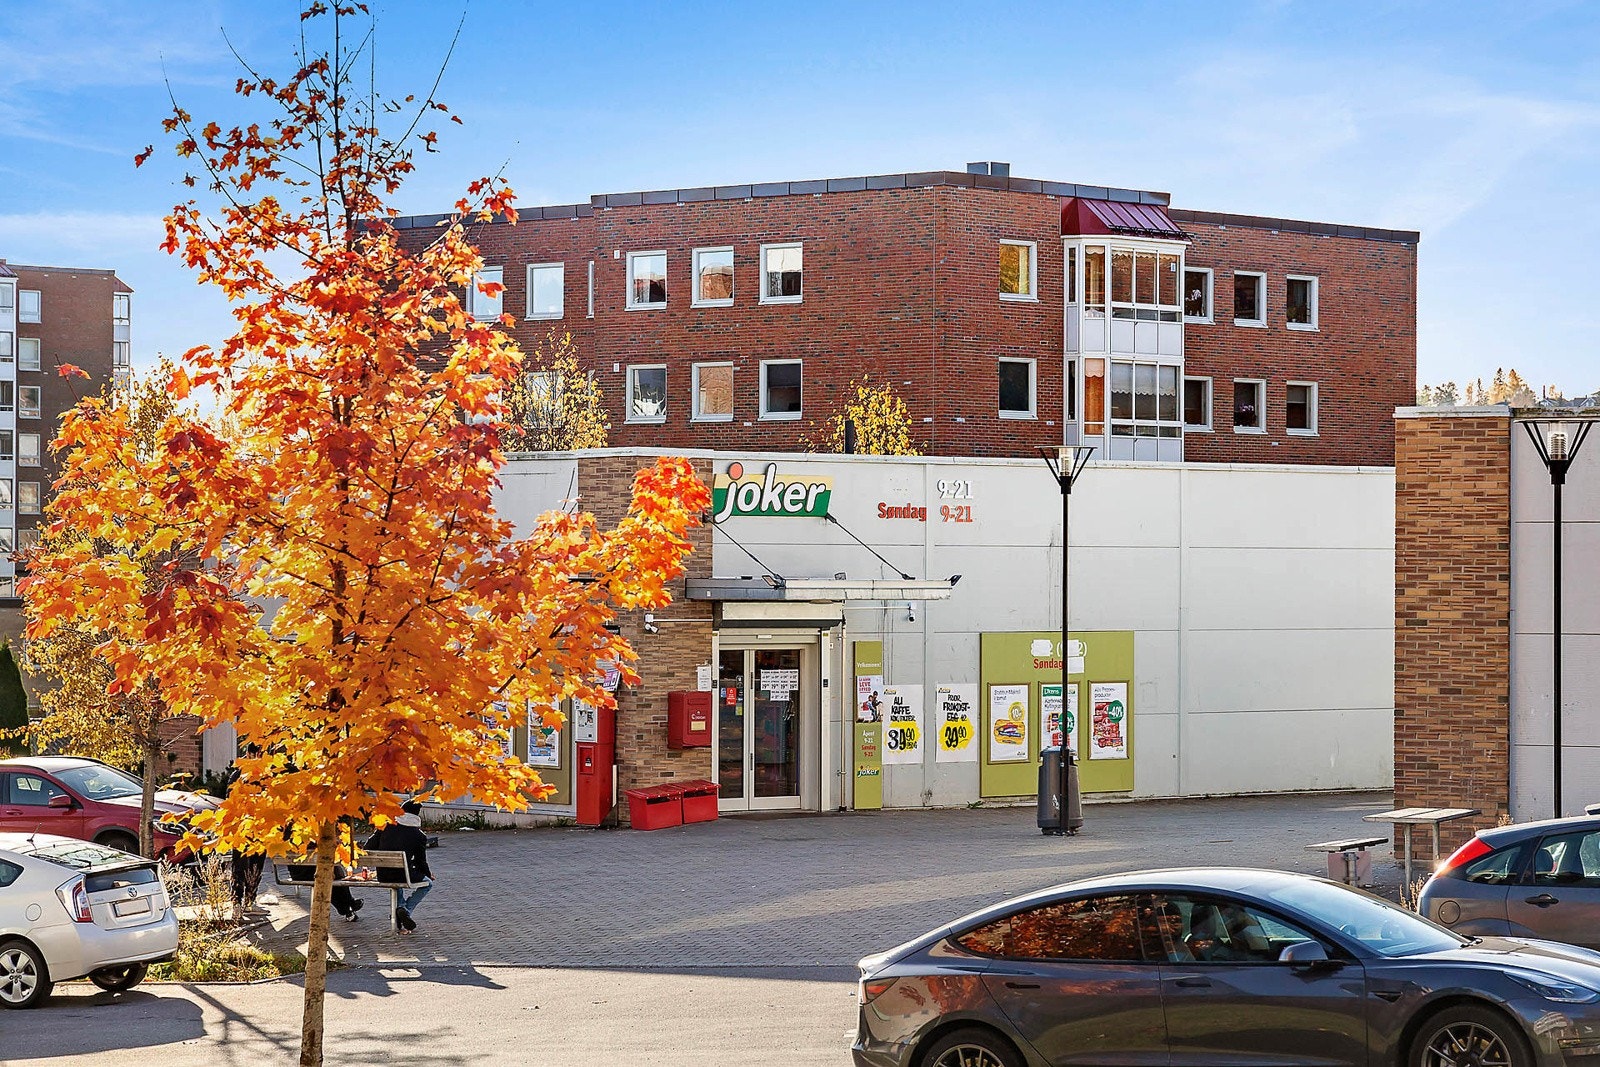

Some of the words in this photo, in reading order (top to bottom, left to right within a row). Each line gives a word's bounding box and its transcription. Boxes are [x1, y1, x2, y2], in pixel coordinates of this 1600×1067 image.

[714, 462, 826, 524] joker
[937, 479, 974, 500] 9-21
[877, 502, 927, 522] Søndag
[939, 505, 974, 523] 9-21
